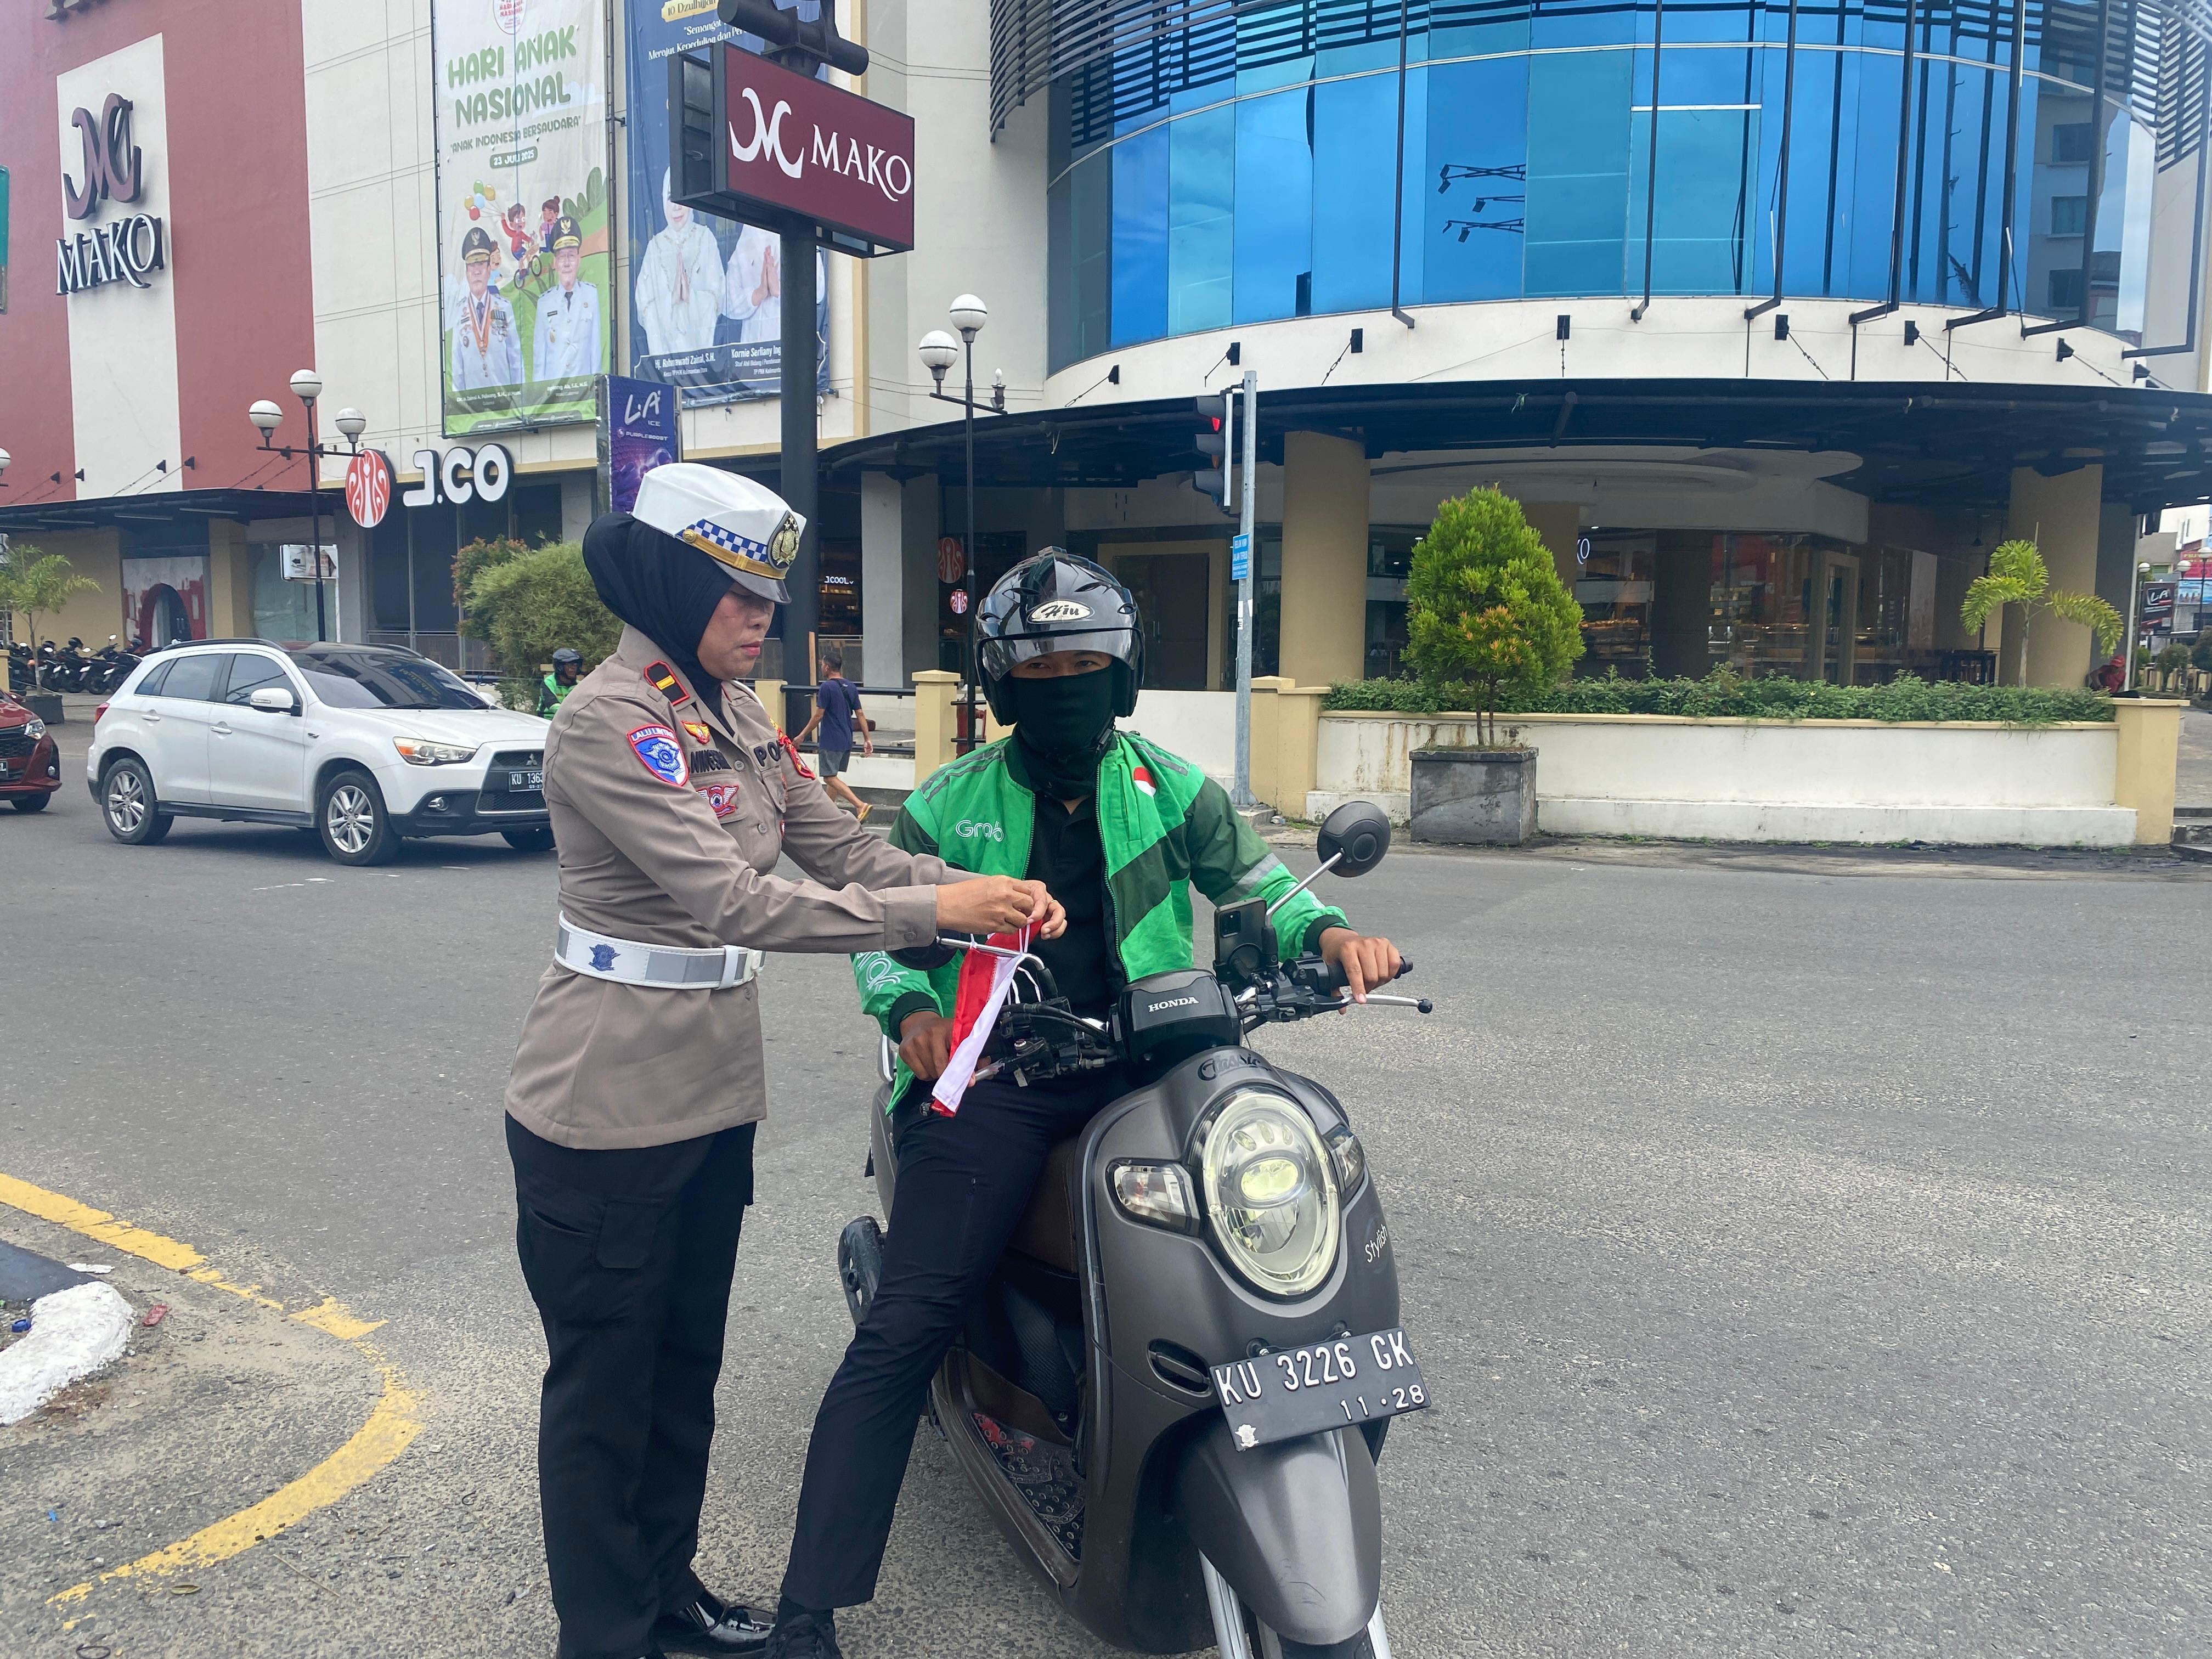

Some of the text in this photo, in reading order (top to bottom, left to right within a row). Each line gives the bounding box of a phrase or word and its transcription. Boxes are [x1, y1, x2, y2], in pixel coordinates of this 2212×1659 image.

[448, 25, 577, 88] HARI ANAK
[455, 71, 571, 128] NASIONAL
[493, 149, 534, 166] 23 JULI 2025
[810, 123, 911, 202] MAKO
[56, 213, 163, 296] MAKO
[403, 443, 509, 506] J.CO
[631, 727, 652, 741] LALU
[511, 773, 522, 785] KU
[955, 820, 1005, 842] Grab
[1148, 996, 1200, 1013] HONDA
[1364, 1224, 1388, 1263] Stylish
[1215, 1330, 1415, 1406] KU 3226 GK
